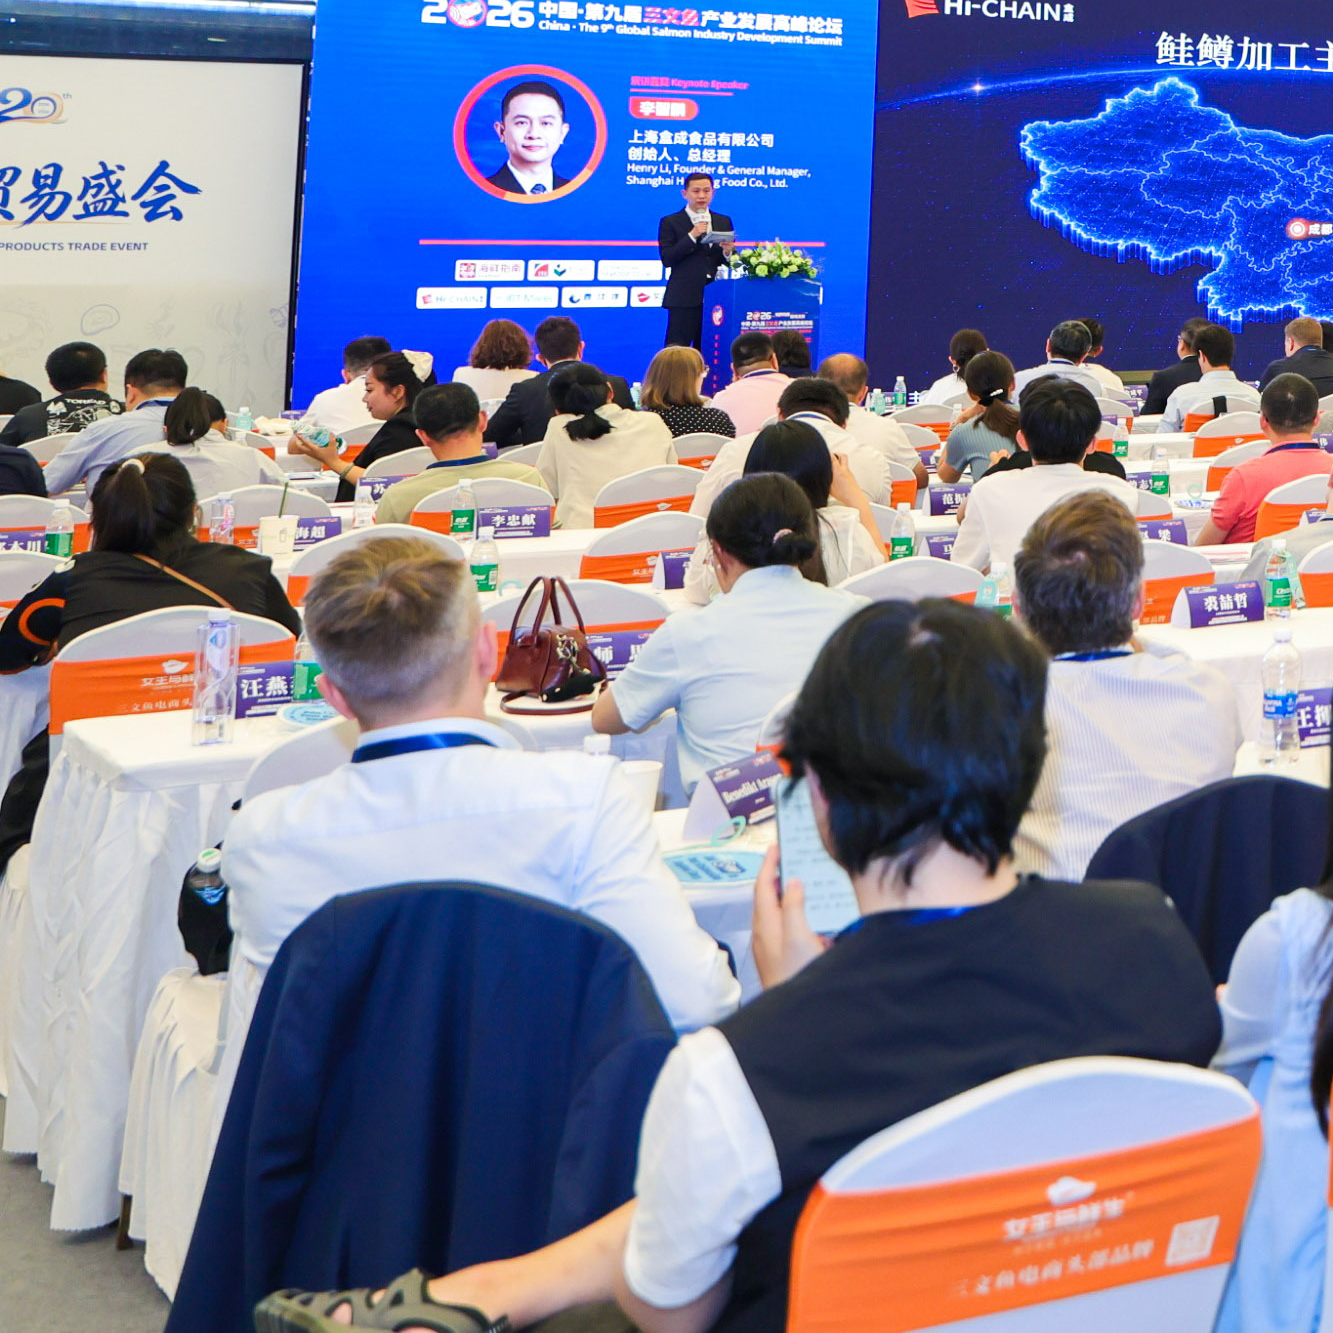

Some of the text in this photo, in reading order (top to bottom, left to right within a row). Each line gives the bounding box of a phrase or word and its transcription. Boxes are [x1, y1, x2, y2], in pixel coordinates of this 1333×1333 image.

[538, 20, 570, 32] China
[579, 22, 599, 33] The
[616, 24, 650, 36] Global
[652, 27, 692, 38] Salmon
[694, 29, 735, 42] Industry
[737, 32, 803, 45] Development
[805, 35, 843, 46] Summit
[628, 146, 731, 163] 创始人、总经理
[627, 163, 658, 175] Henry
[674, 165, 715, 175] Founder
[717, 166, 725, 175] &
[727, 166, 765, 176] General
[767, 167, 811, 178] Manager,
[626, 176, 674, 188] Shanghai
[722, 177, 747, 187] Food
[749, 178, 767, 188] Co.,
[770, 178, 788, 188] Ltd.
[1308, 223, 1333, 235] 成都
[68, 242, 107, 252] TRADE
[110, 242, 148, 252] EVENT
